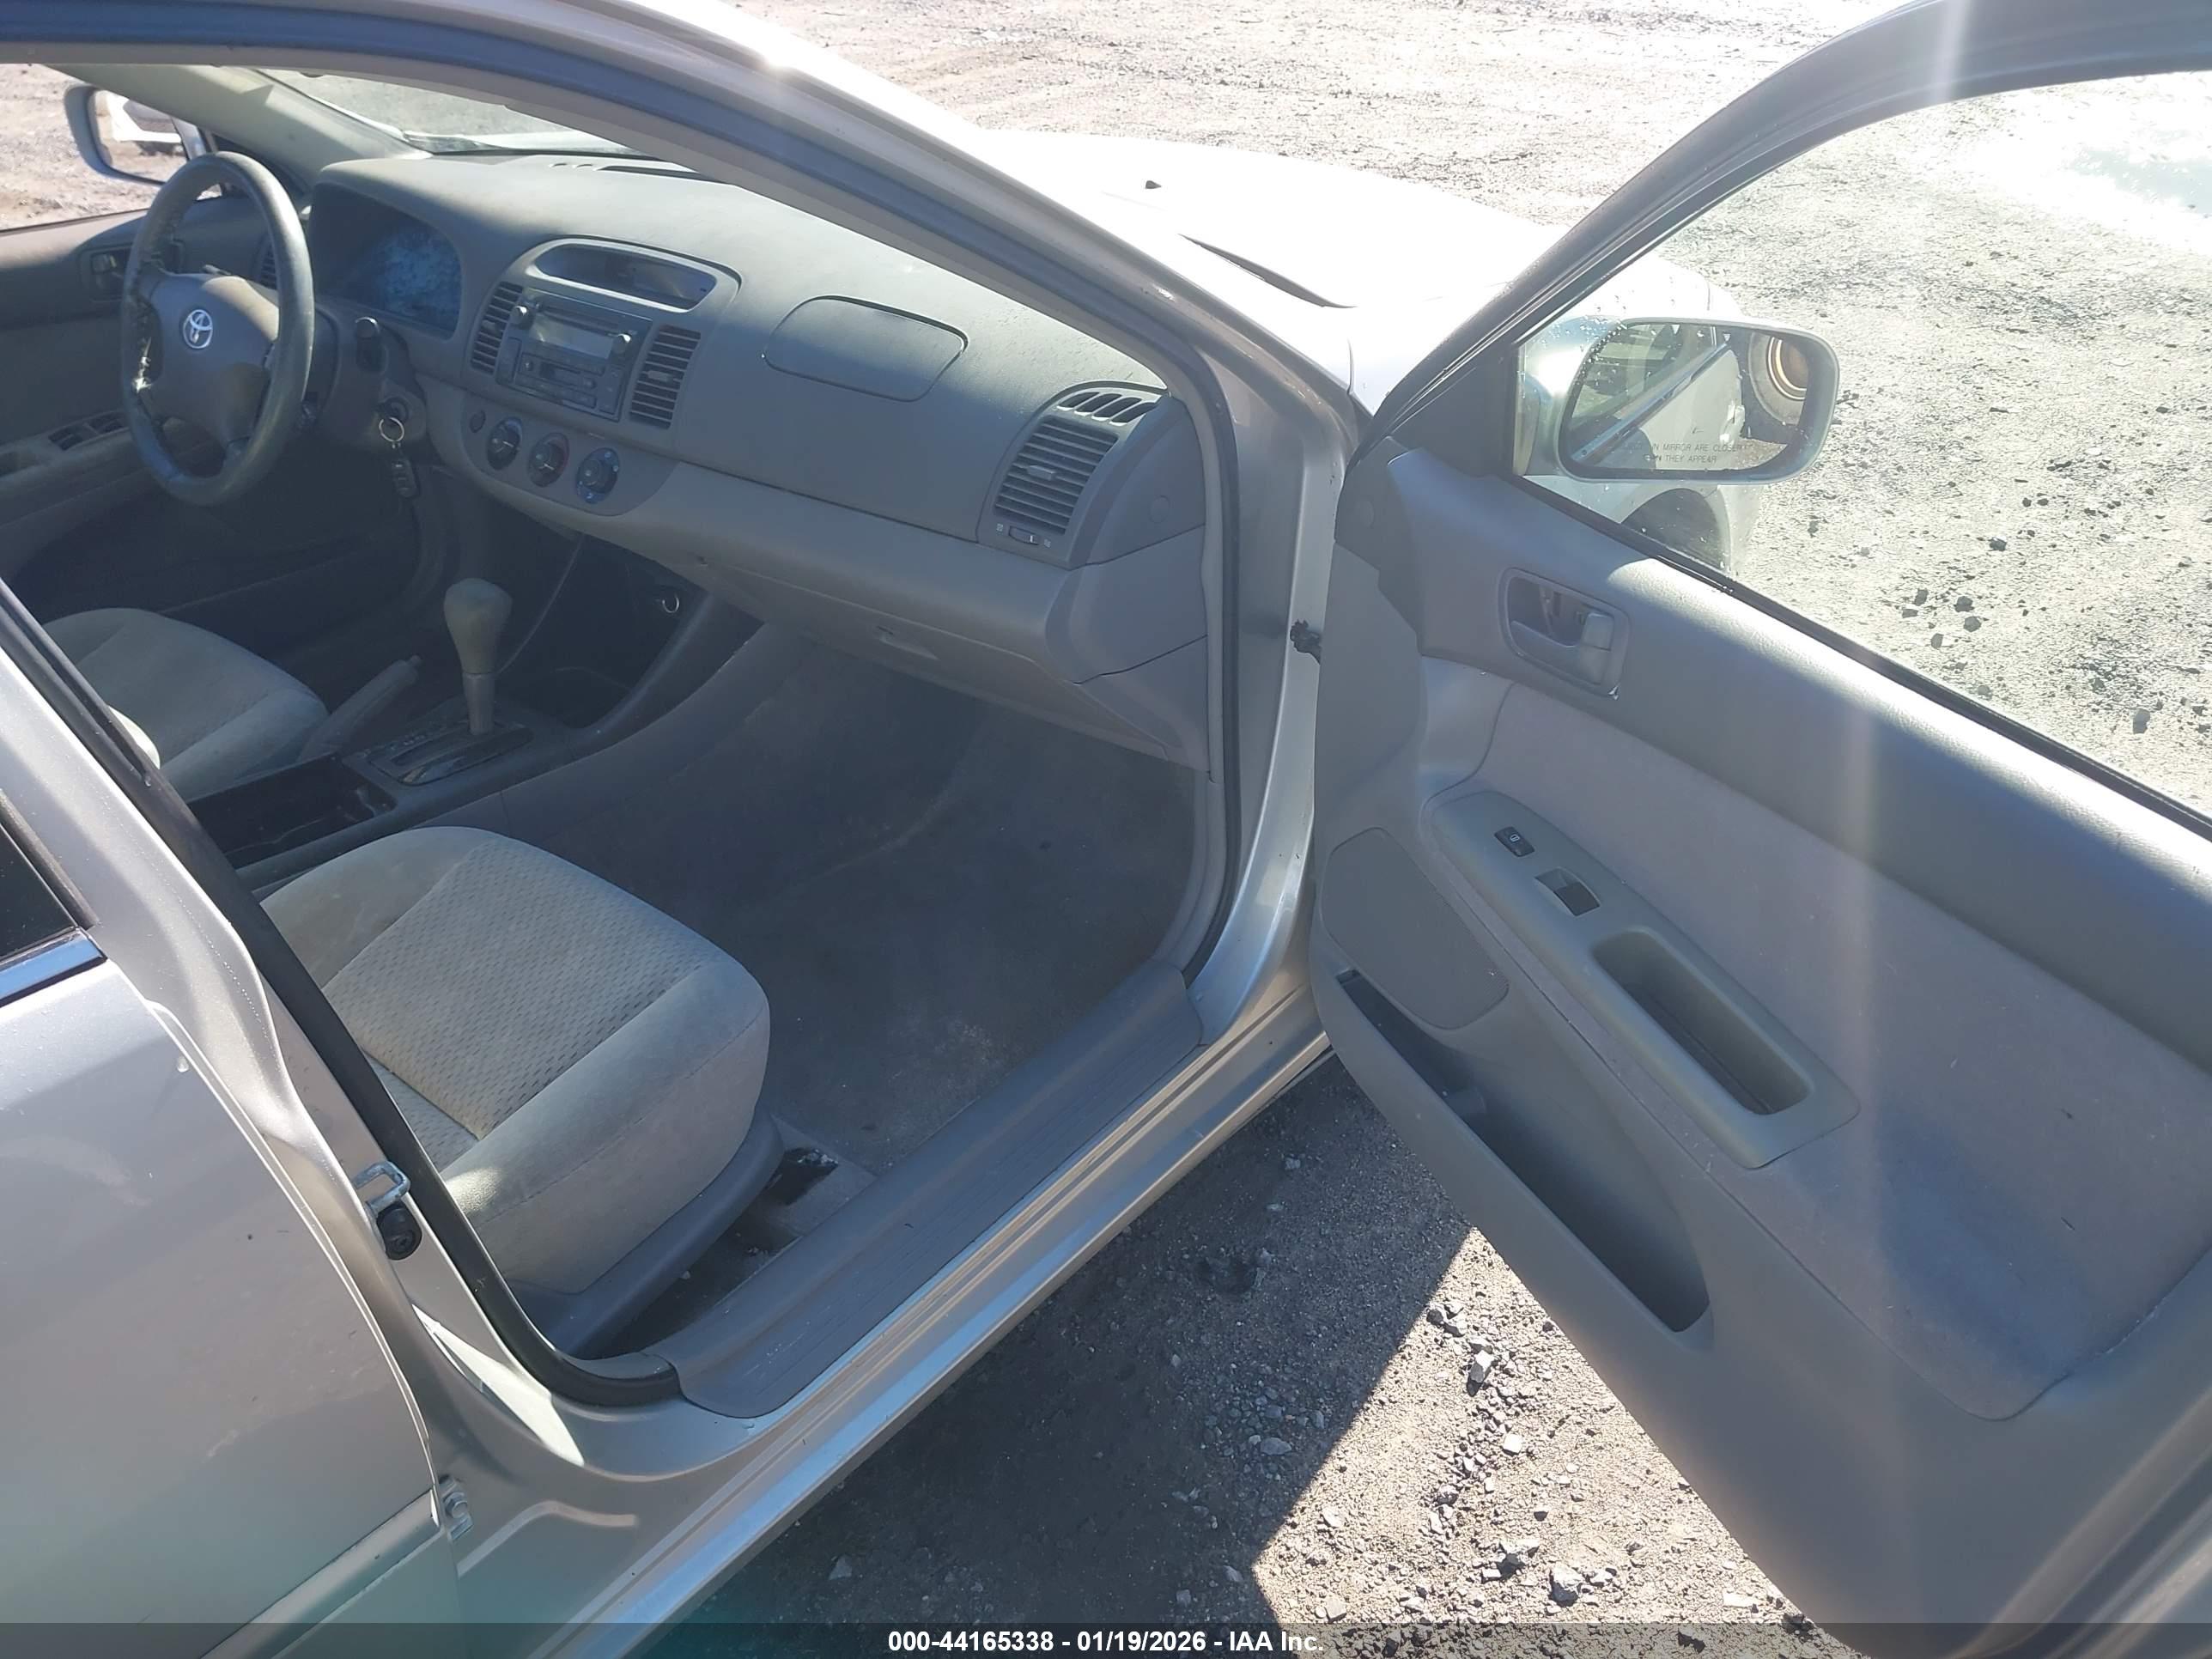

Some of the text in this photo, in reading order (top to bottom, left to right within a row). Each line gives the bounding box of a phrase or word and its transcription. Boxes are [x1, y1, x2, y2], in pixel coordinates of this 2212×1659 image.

[1662, 443, 1692, 452] MIRROR
[1694, 443, 1710, 452] ARE
[1665, 454, 1685, 463] THEY
[1687, 454, 1717, 464] APPEAR
